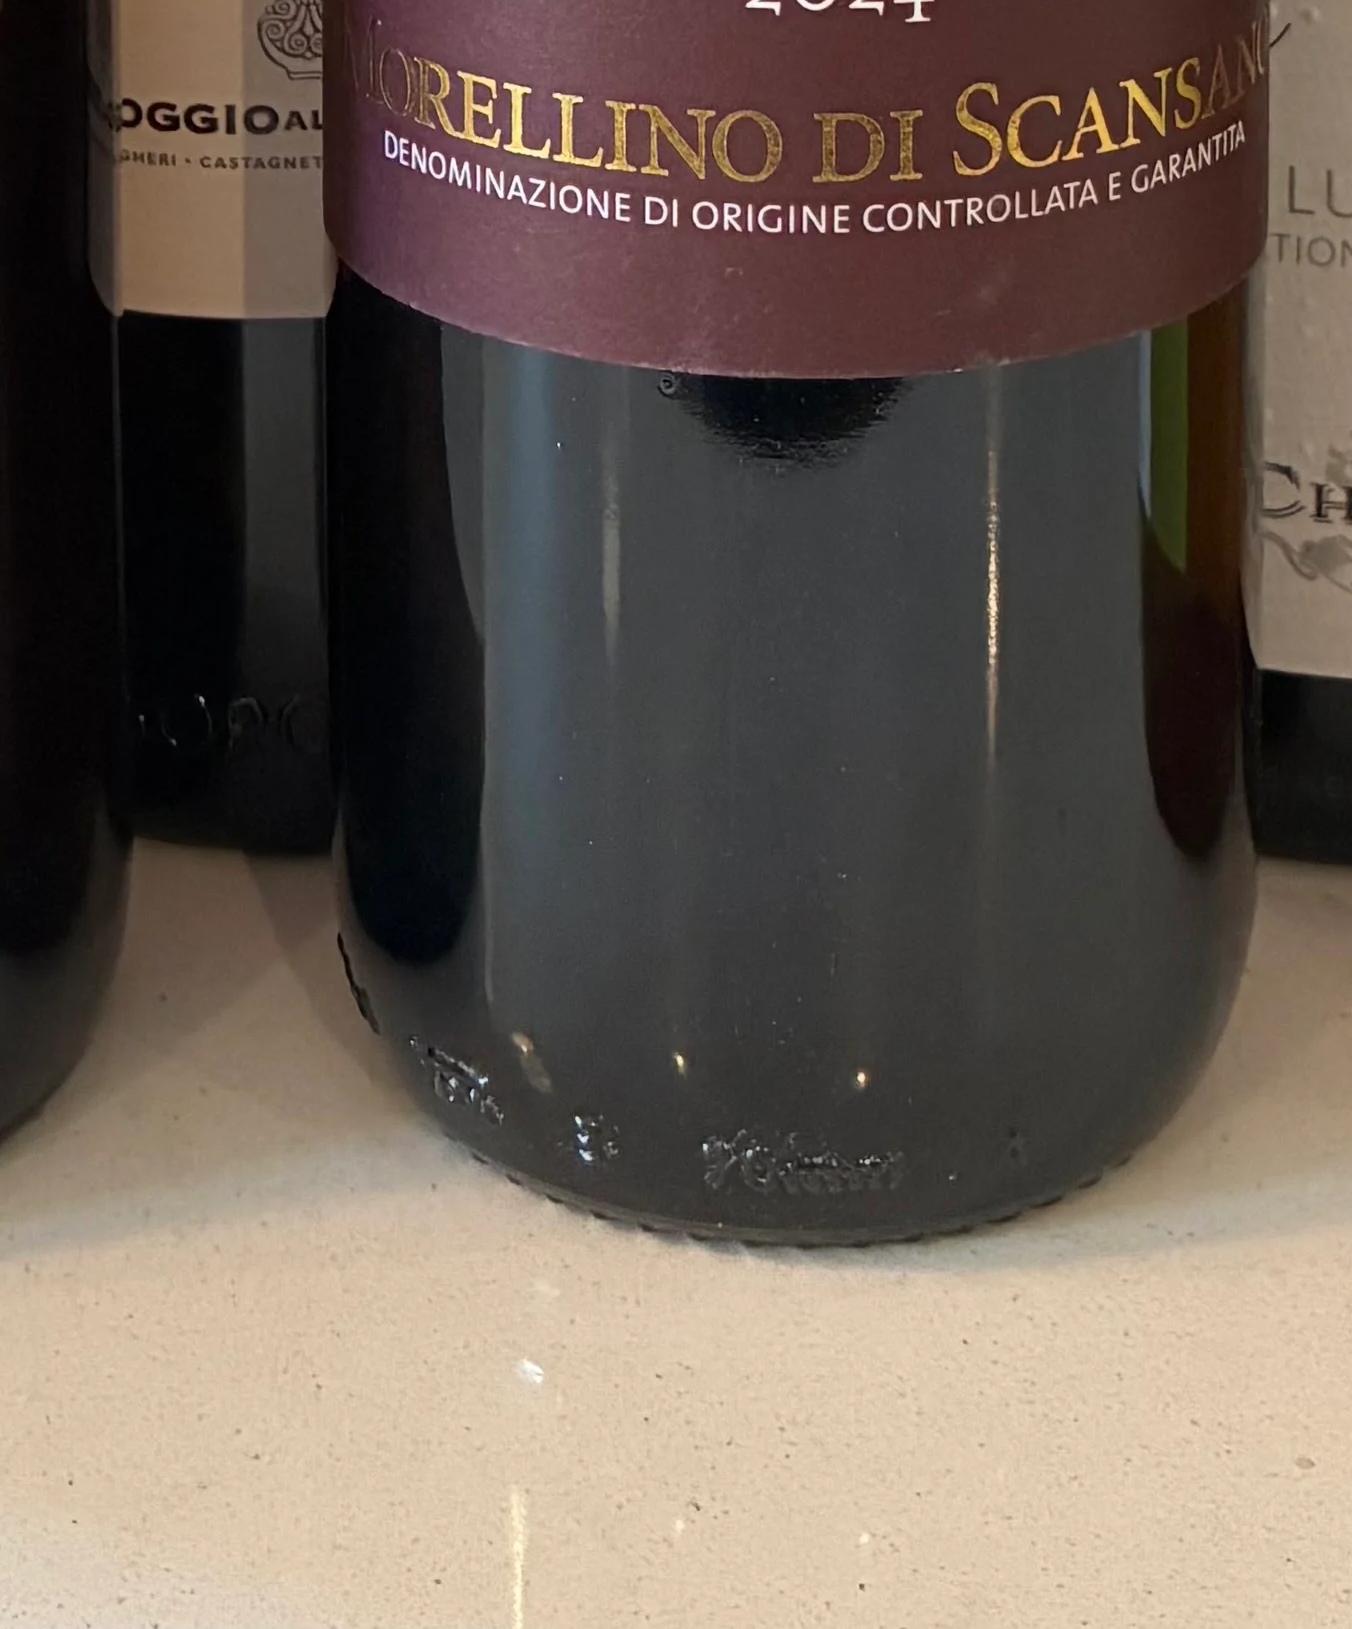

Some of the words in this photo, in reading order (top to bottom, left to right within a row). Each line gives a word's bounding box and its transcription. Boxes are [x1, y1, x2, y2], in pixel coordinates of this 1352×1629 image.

[384, 130, 631, 223] DENOMINAZIONE
[644, 197, 679, 228] DI
[692, 202, 850, 234] ORIGINE
[862, 178, 1098, 233] CONTROLLATA
[1108, 172, 1122, 202] E
[1130, 119, 1246, 194] GARANTITA
[813, 109, 923, 184] DI
